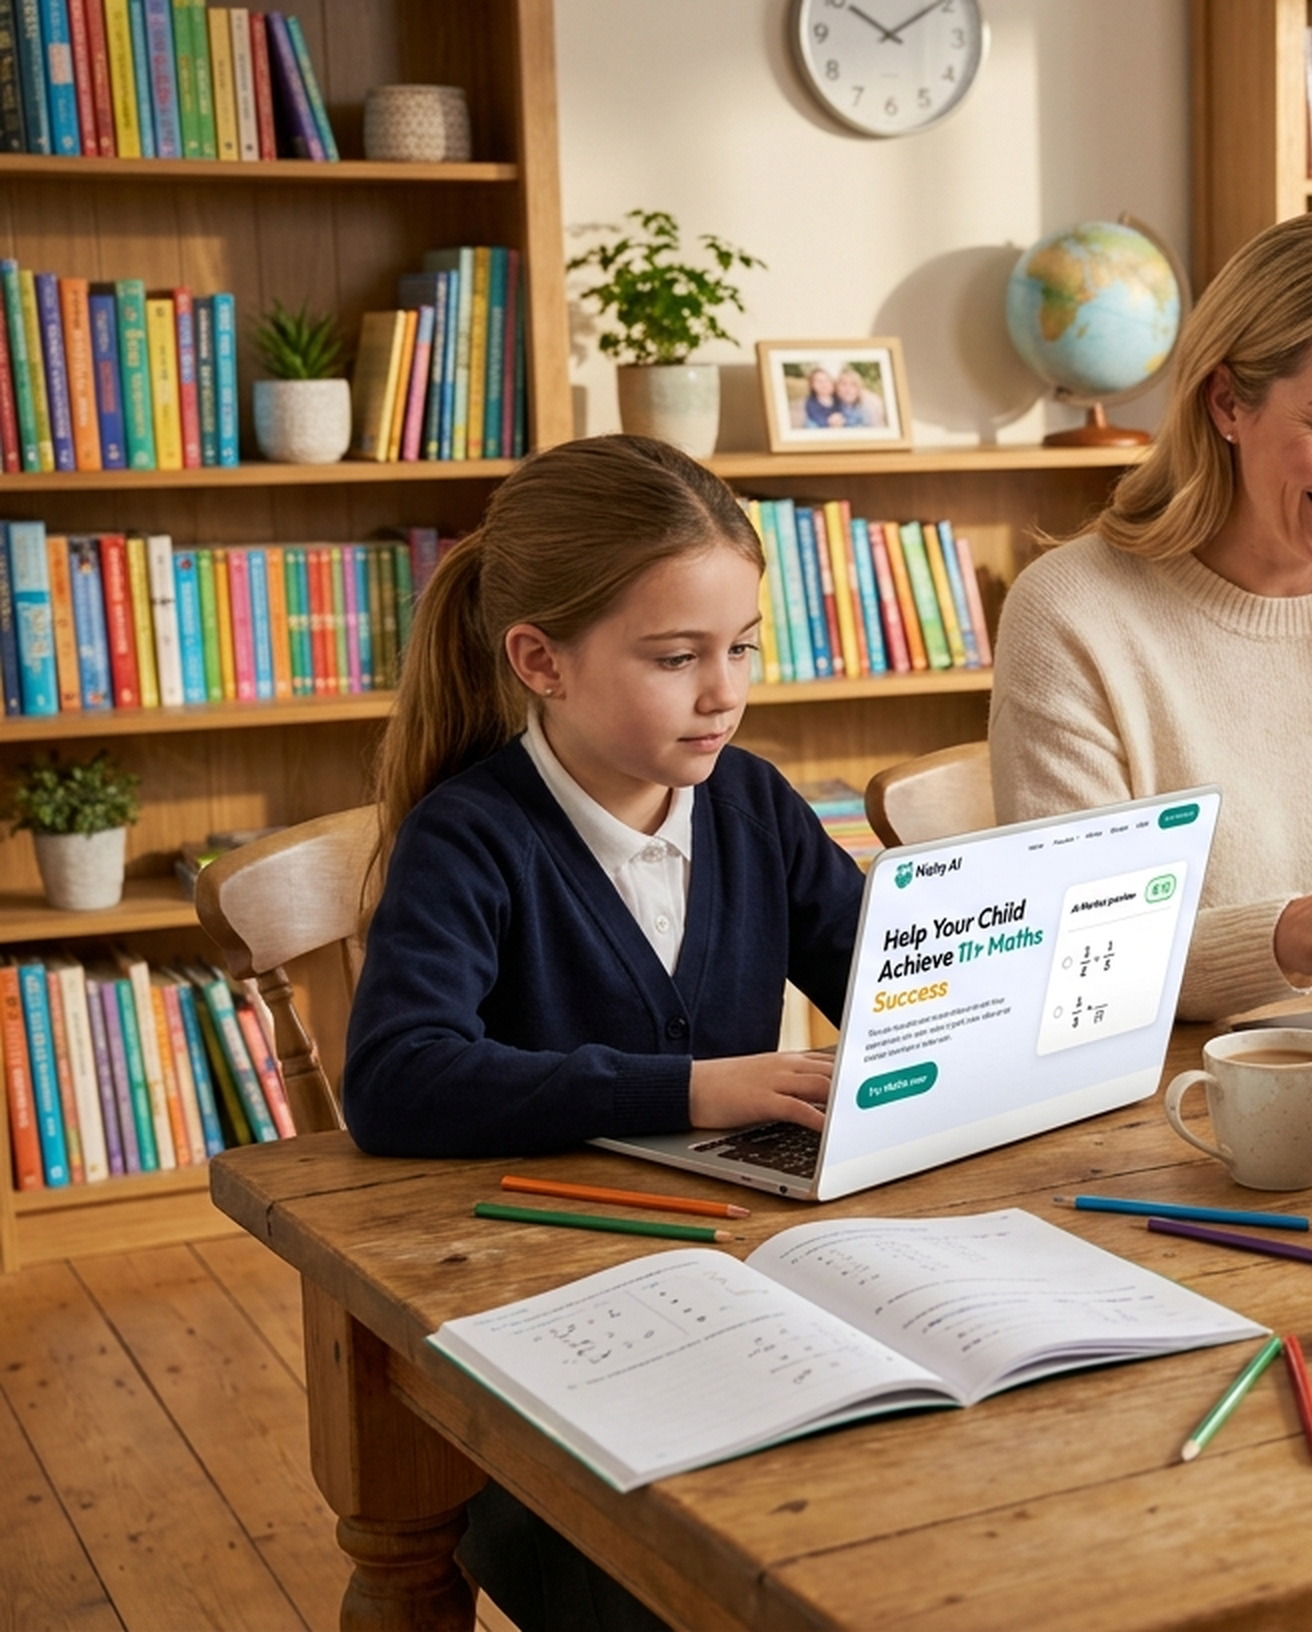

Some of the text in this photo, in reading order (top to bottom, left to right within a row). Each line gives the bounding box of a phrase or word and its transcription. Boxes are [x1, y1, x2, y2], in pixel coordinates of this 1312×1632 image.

[813, 24, 829, 44] 9
[952, 29, 966, 49] 3
[826, 60, 840, 81] 8
[942, 66, 956, 82] 4
[852, 87, 864, 107] 7
[884, 98, 899, 116] 6
[917, 88, 932, 109] 5
[884, 924, 927, 951] Help
[934, 917, 974, 940] Your
[877, 950, 954, 982] Achieve
[987, 927, 1044, 956] Maths
[872, 981, 949, 1013] Success
